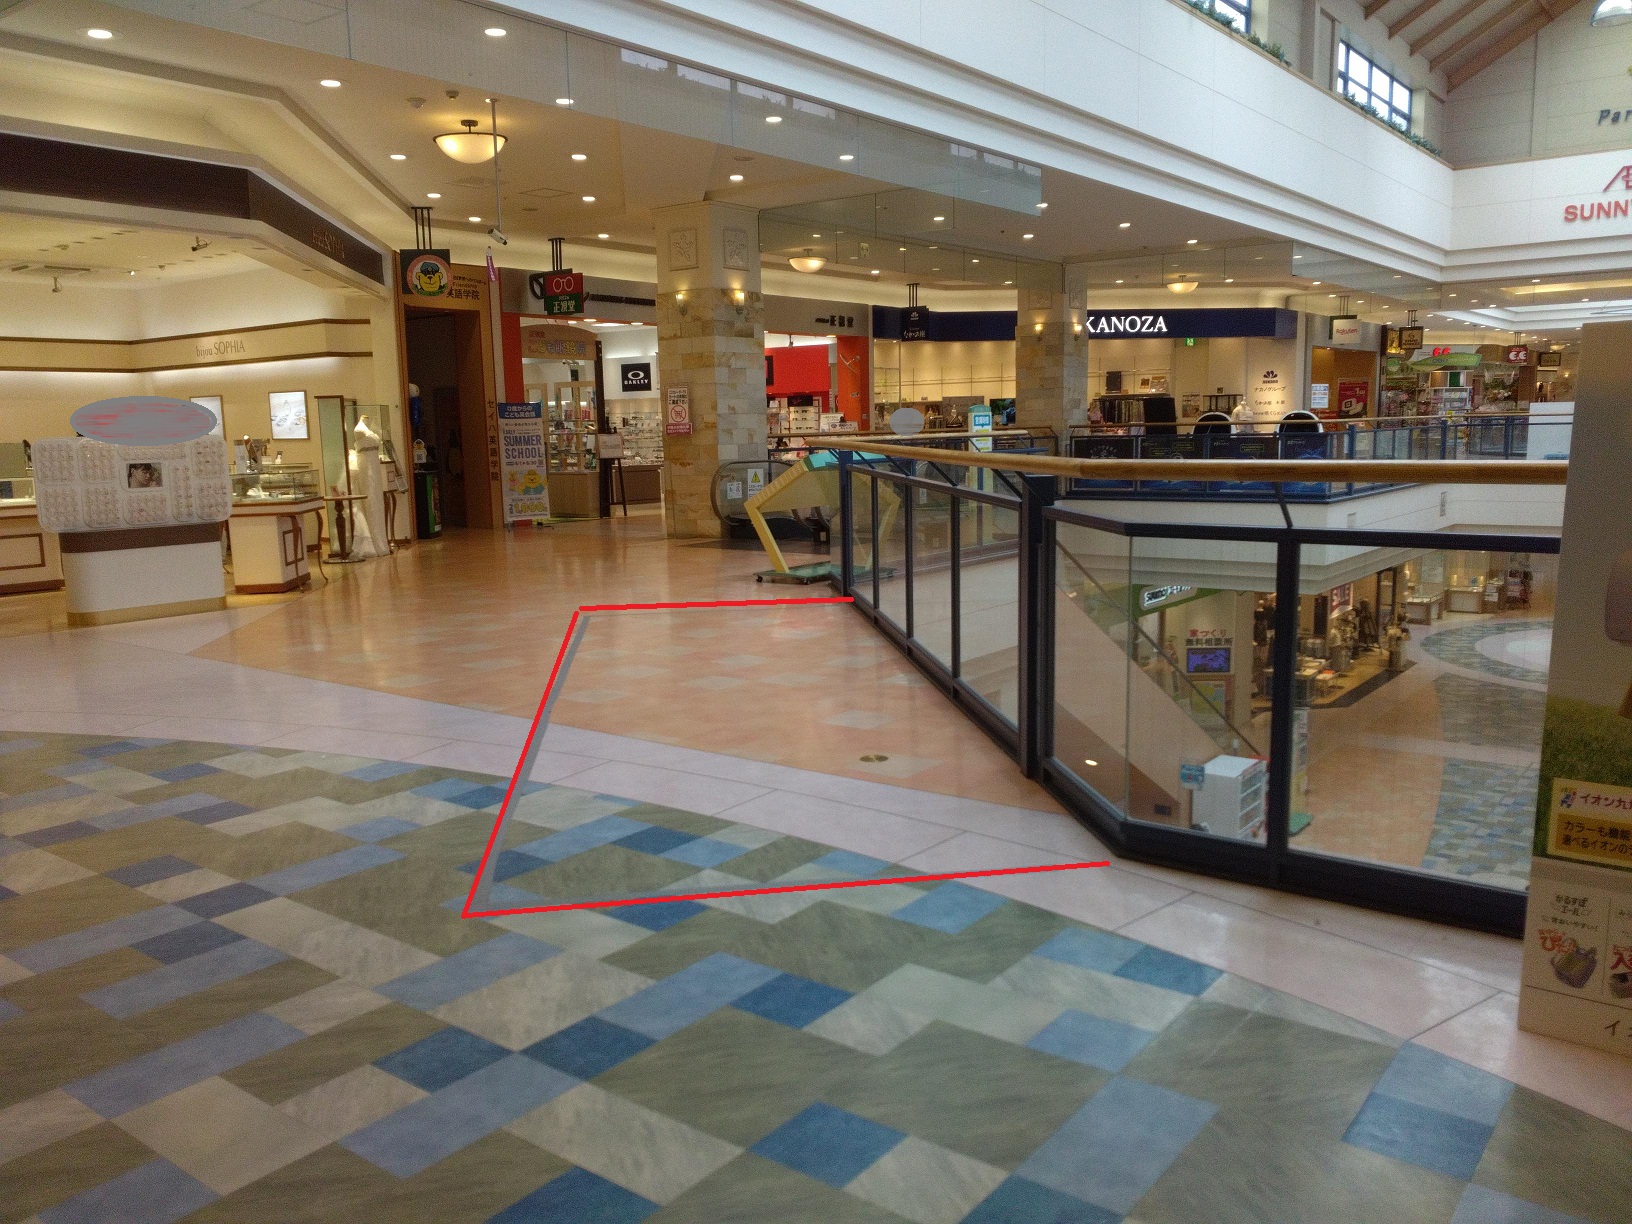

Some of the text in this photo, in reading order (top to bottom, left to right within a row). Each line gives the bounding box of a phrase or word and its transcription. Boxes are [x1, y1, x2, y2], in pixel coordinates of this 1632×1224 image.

[1086, 315, 1168, 333] KANOZA
[1336, 328, 1358, 336] Rakuten
[196, 340, 246, 359] bijou SOPHIA
[504, 435, 542, 447] SUMMER
[505, 446, 543, 459] SCHOOL
[1189, 629, 1227, 637] 家づくり
[1580, 793, 1632, 810] イオン九
